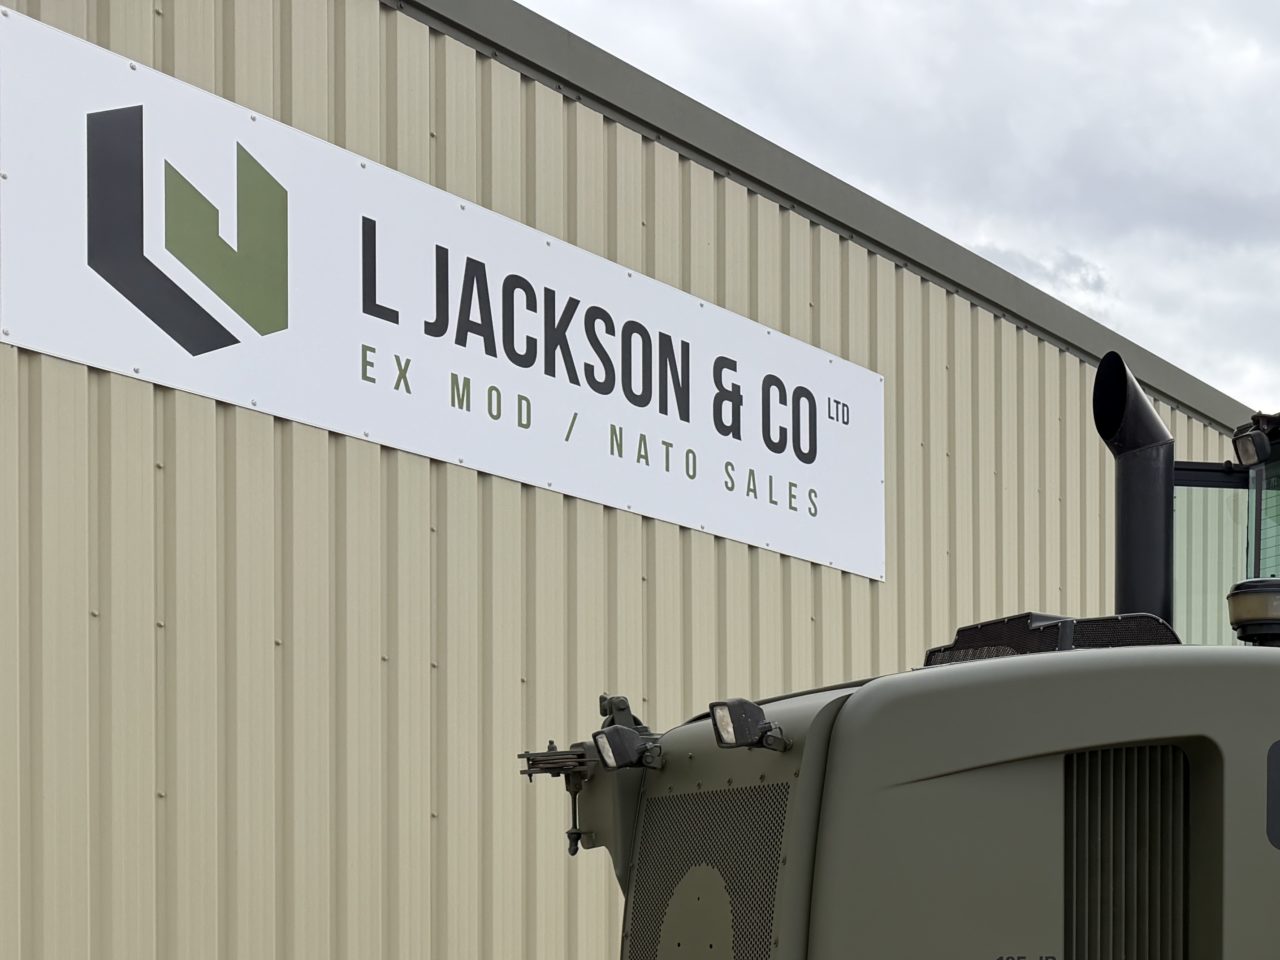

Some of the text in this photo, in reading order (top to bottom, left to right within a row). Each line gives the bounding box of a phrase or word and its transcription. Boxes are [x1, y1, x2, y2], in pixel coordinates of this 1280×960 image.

[361, 343, 412, 395] EX
[450, 373, 532, 430] MOD
[609, 423, 697, 481] NATO
[724, 460, 819, 518] SALES
[362, 216, 850, 464] L JACKSON & CO LTD
